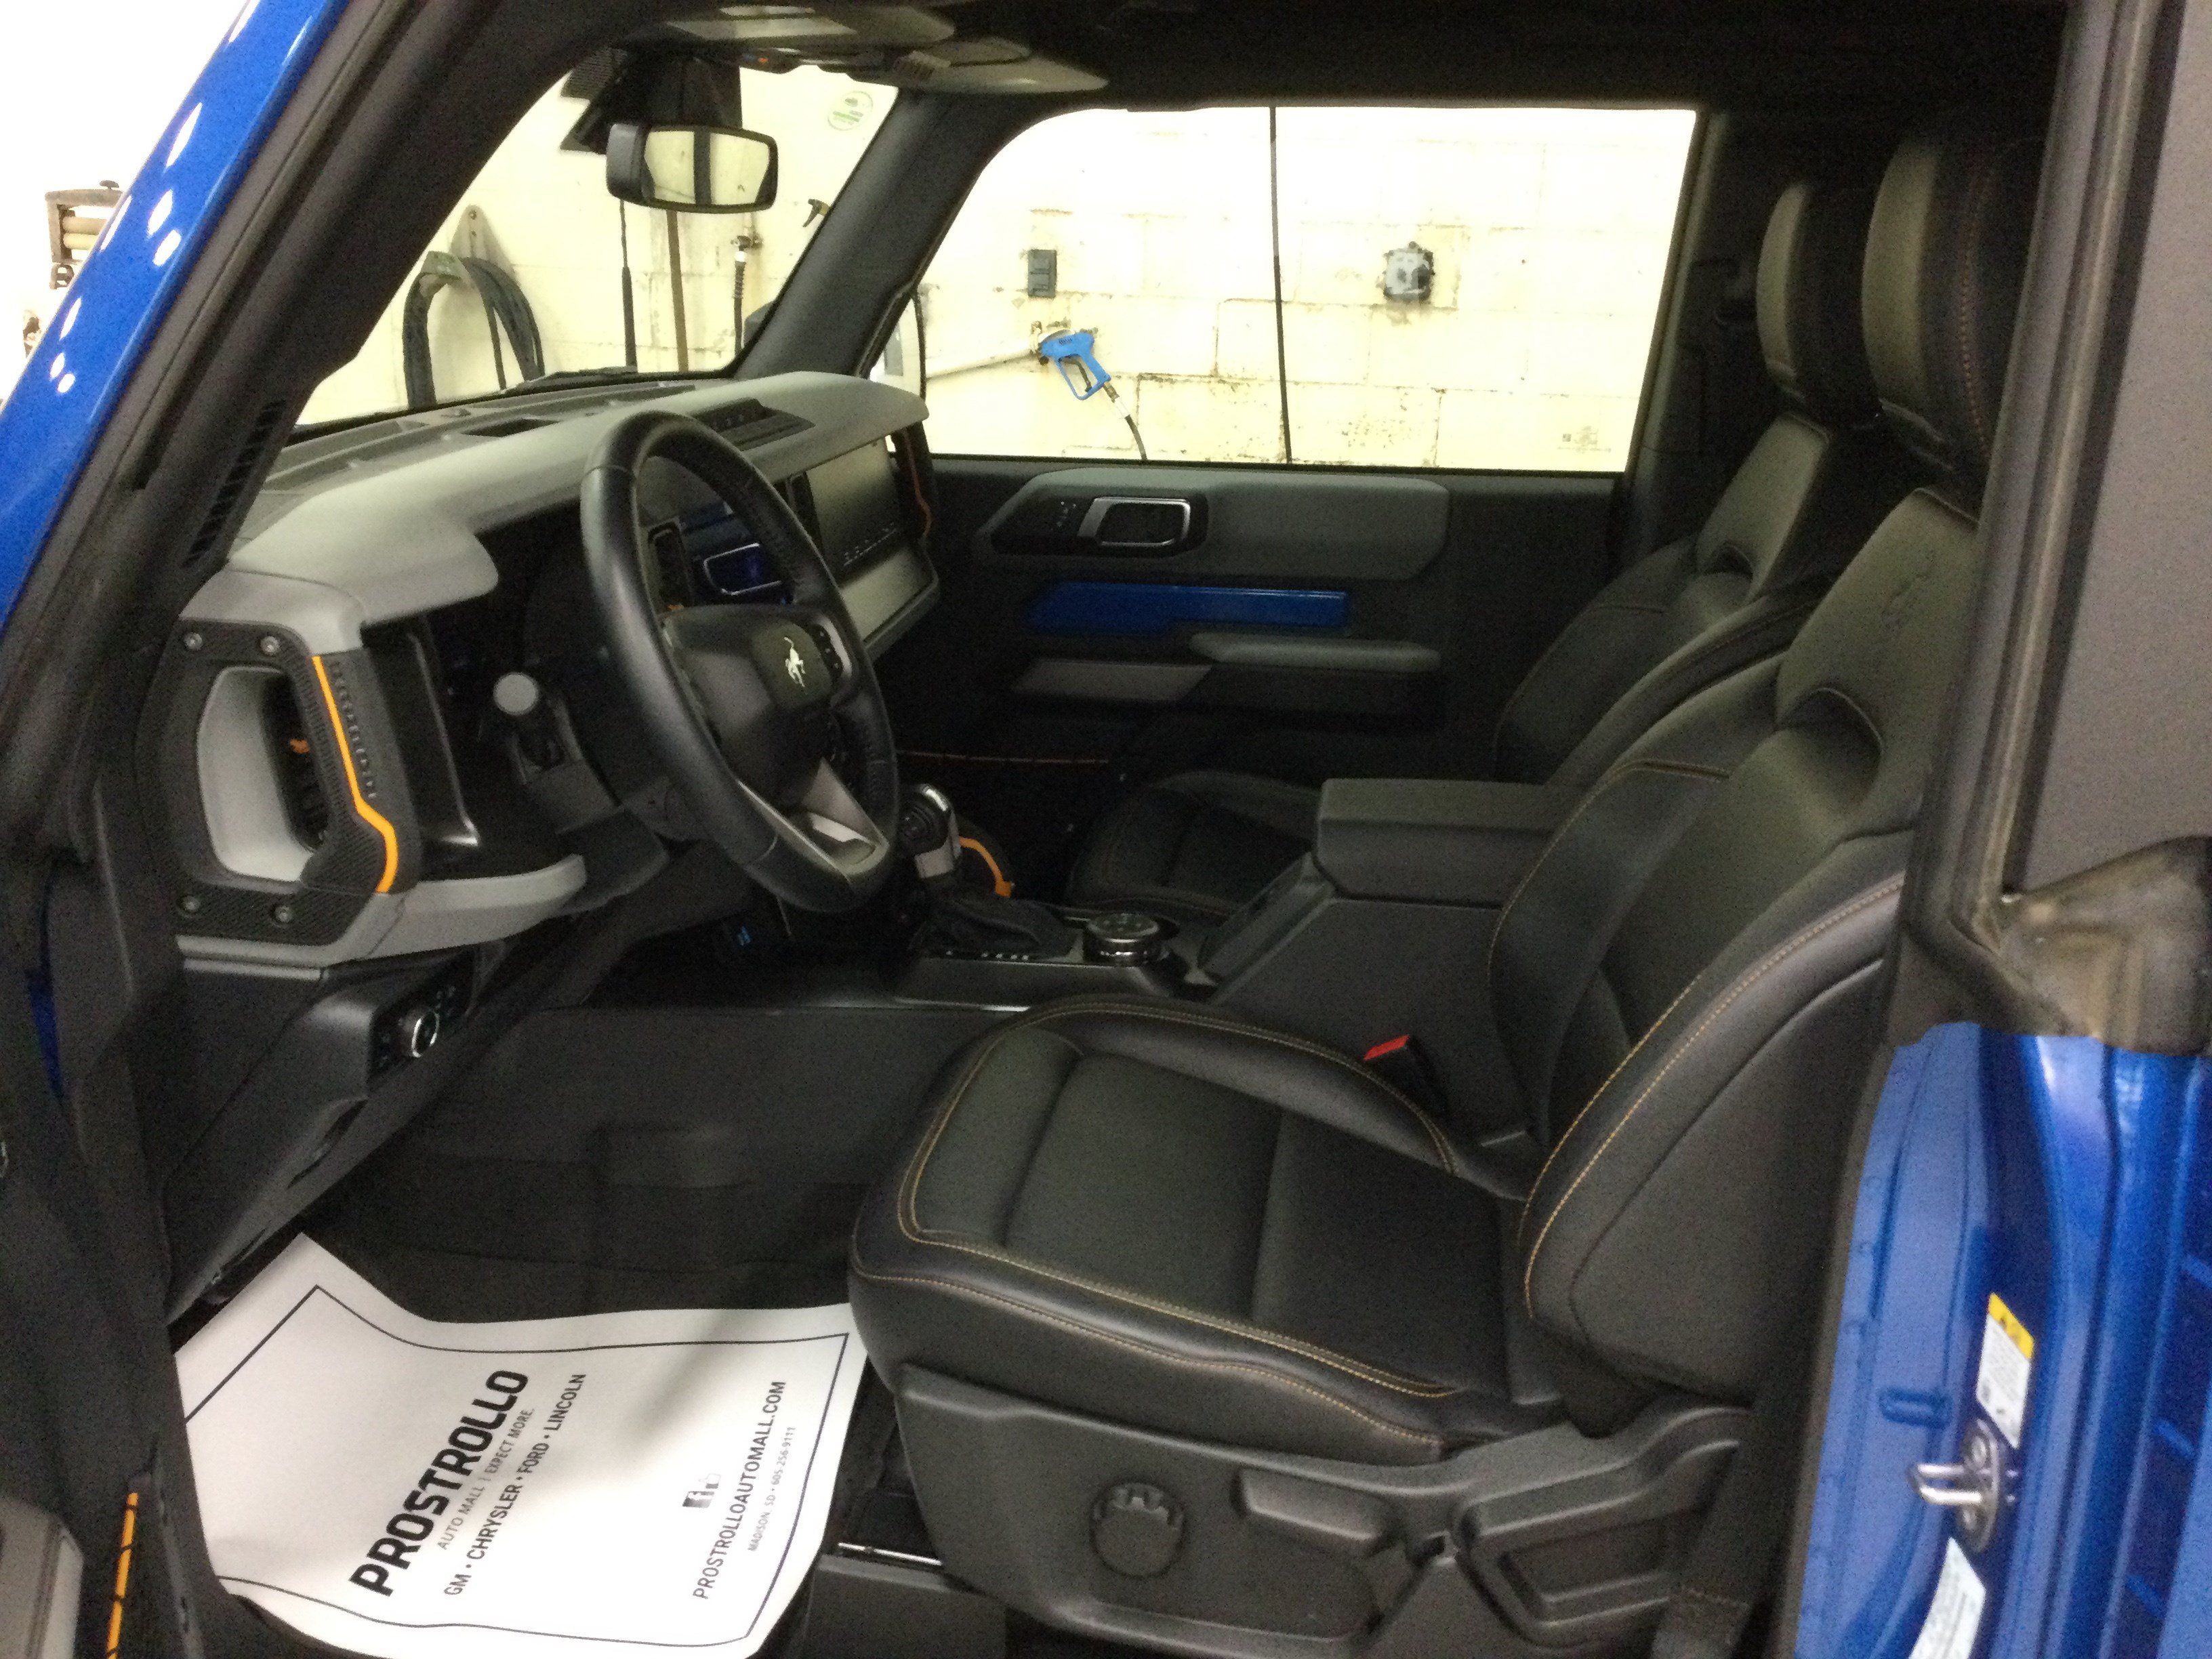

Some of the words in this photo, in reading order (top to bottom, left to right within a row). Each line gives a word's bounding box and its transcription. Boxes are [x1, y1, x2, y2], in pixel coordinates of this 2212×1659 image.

[348, 1370, 528, 1597] PROSTROLLO
[437, 1518, 464, 1549] AUTO
[458, 1486, 486, 1517] MALL
[484, 1439, 514, 1475] EXPECT
[444, 1574, 472, 1595] GM
[467, 1483, 523, 1560] CHRYSLER
[516, 1442, 550, 1474] FORD
[544, 1374, 586, 1432] LINCOLN
[693, 1381, 786, 1599] PROSTROLLOAUTOMALL.COM
